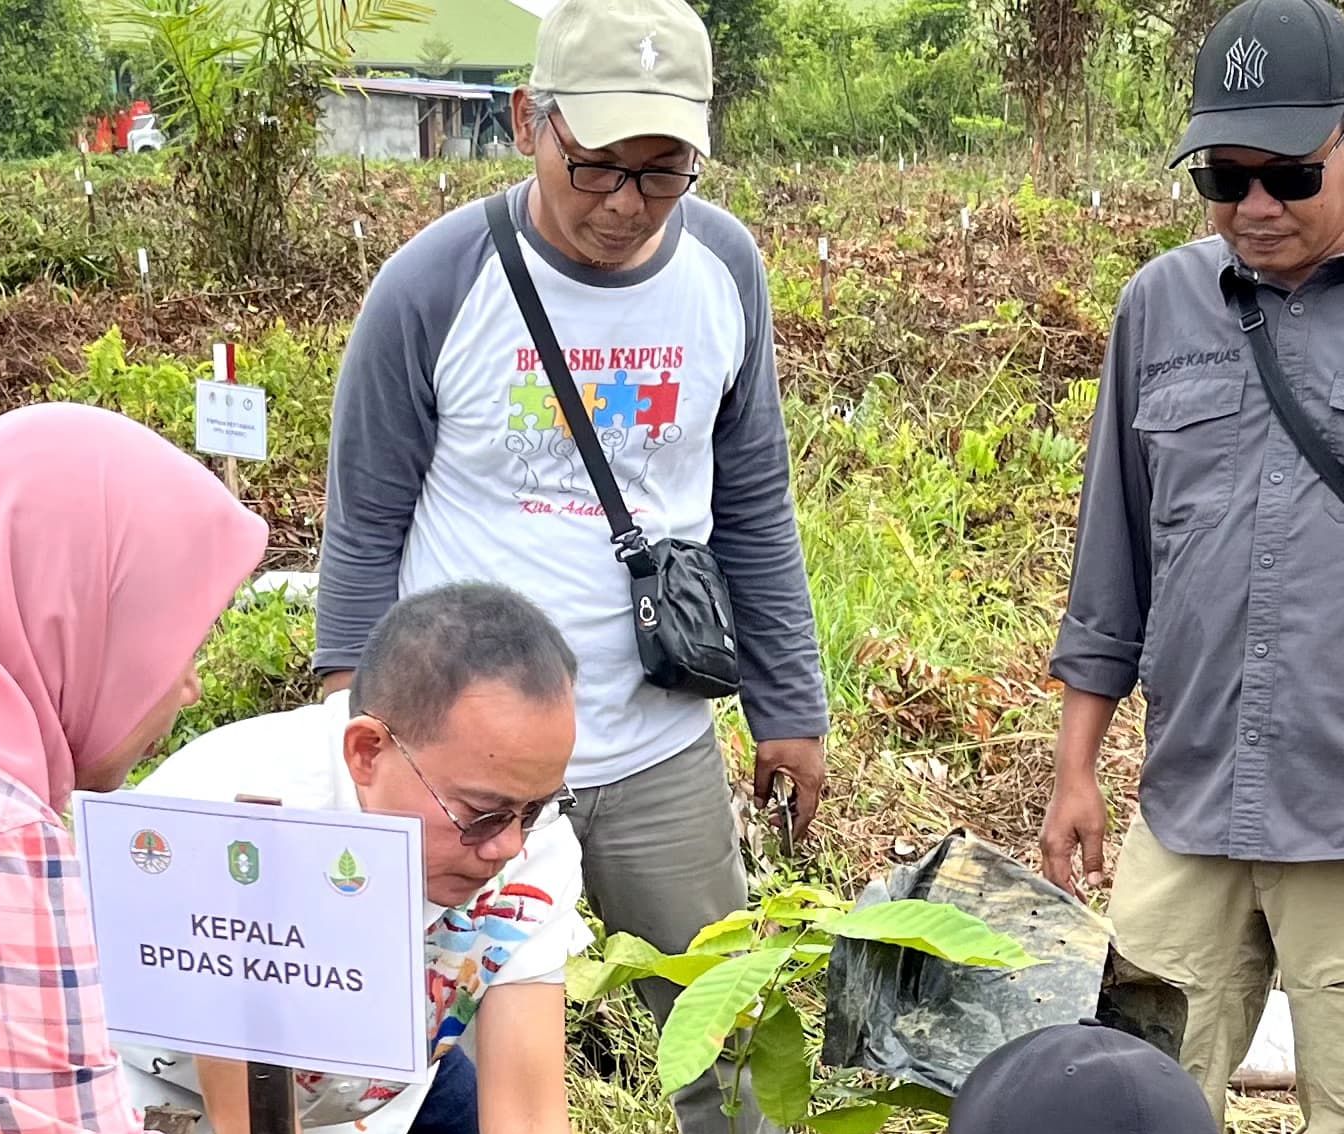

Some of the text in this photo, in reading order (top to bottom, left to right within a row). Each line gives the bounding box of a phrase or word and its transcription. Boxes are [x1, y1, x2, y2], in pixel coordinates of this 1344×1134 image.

[609, 346, 683, 370] KAPUAS
[1185, 349, 1241, 367] KAPUAS
[518, 499, 554, 515] Kita
[191, 913, 306, 949] KEPALA
[140, 943, 364, 993] BPDAS KAPUAS
